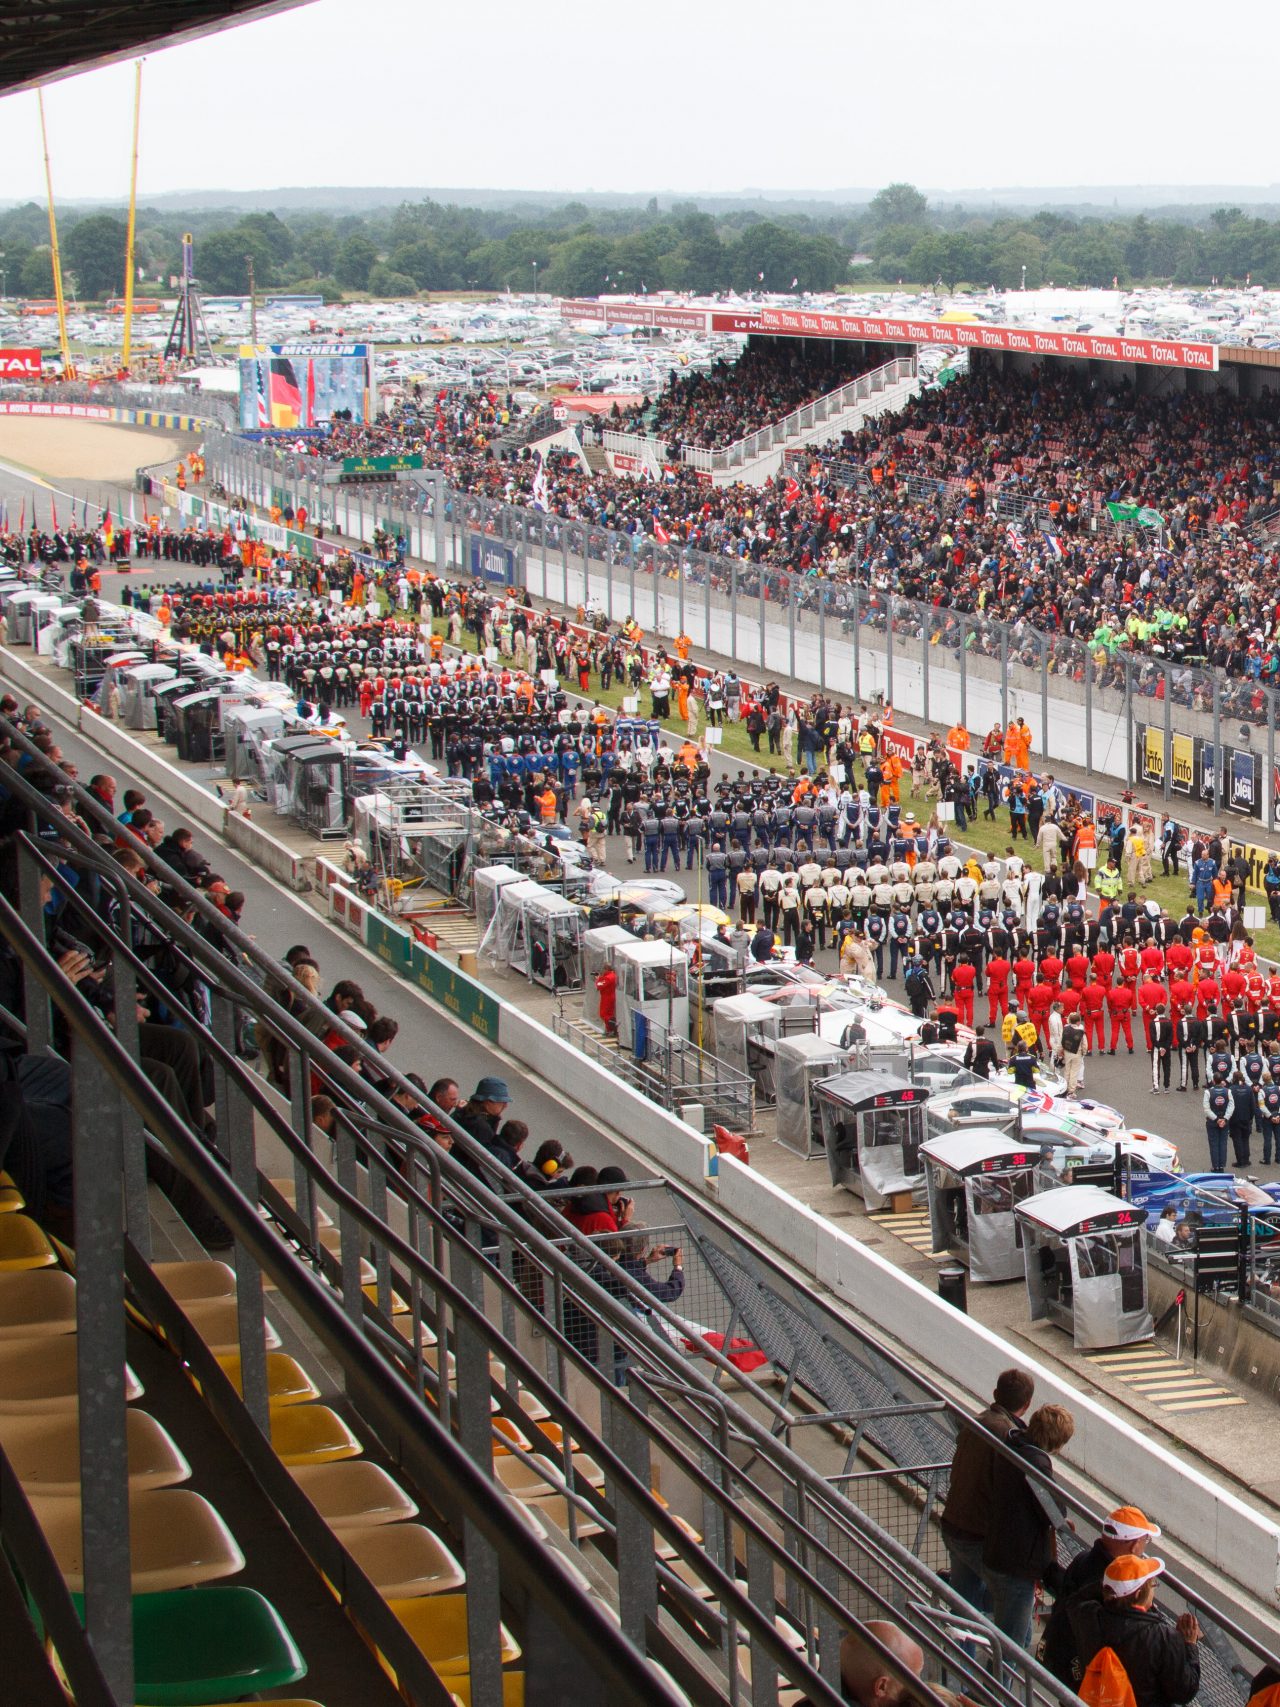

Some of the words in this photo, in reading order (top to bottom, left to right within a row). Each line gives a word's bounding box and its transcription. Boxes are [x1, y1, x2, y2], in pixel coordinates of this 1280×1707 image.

[734, 319, 746, 329] Le
[782, 313, 799, 327] TOTAL
[801, 315, 819, 329] TOTAL
[820, 317, 839, 331] TOTAL
[841, 319, 860, 333] TOTAL
[862, 321, 882, 335] TOTAL
[885, 322, 905, 337] TOTAL
[907, 324, 928, 339] TOTAL
[931, 326, 953, 341] TOTAL
[956, 328, 978, 343] TOTAL
[981, 330, 1004, 345] TOTAL
[1007, 332, 1031, 348] TOTAL
[1034, 335, 1059, 351] TOTAL
[1062, 337, 1088, 353] TOTAL
[1091, 340, 1117, 356] TOTAL
[1120, 342, 1147, 359] TOTAL
[1150, 345, 1178, 362] TOTAL
[1183, 347, 1211, 365] TOTAL
[281, 345, 356, 355] MICHELIN
[555, 410, 567, 418] 22
[1175, 760, 1192, 781] info
[1234, 777, 1252, 801] bleu
[901, 1090, 914, 1100] 45
[1012, 1154, 1026, 1165] 35
[1117, 1212, 1132, 1224] 24
